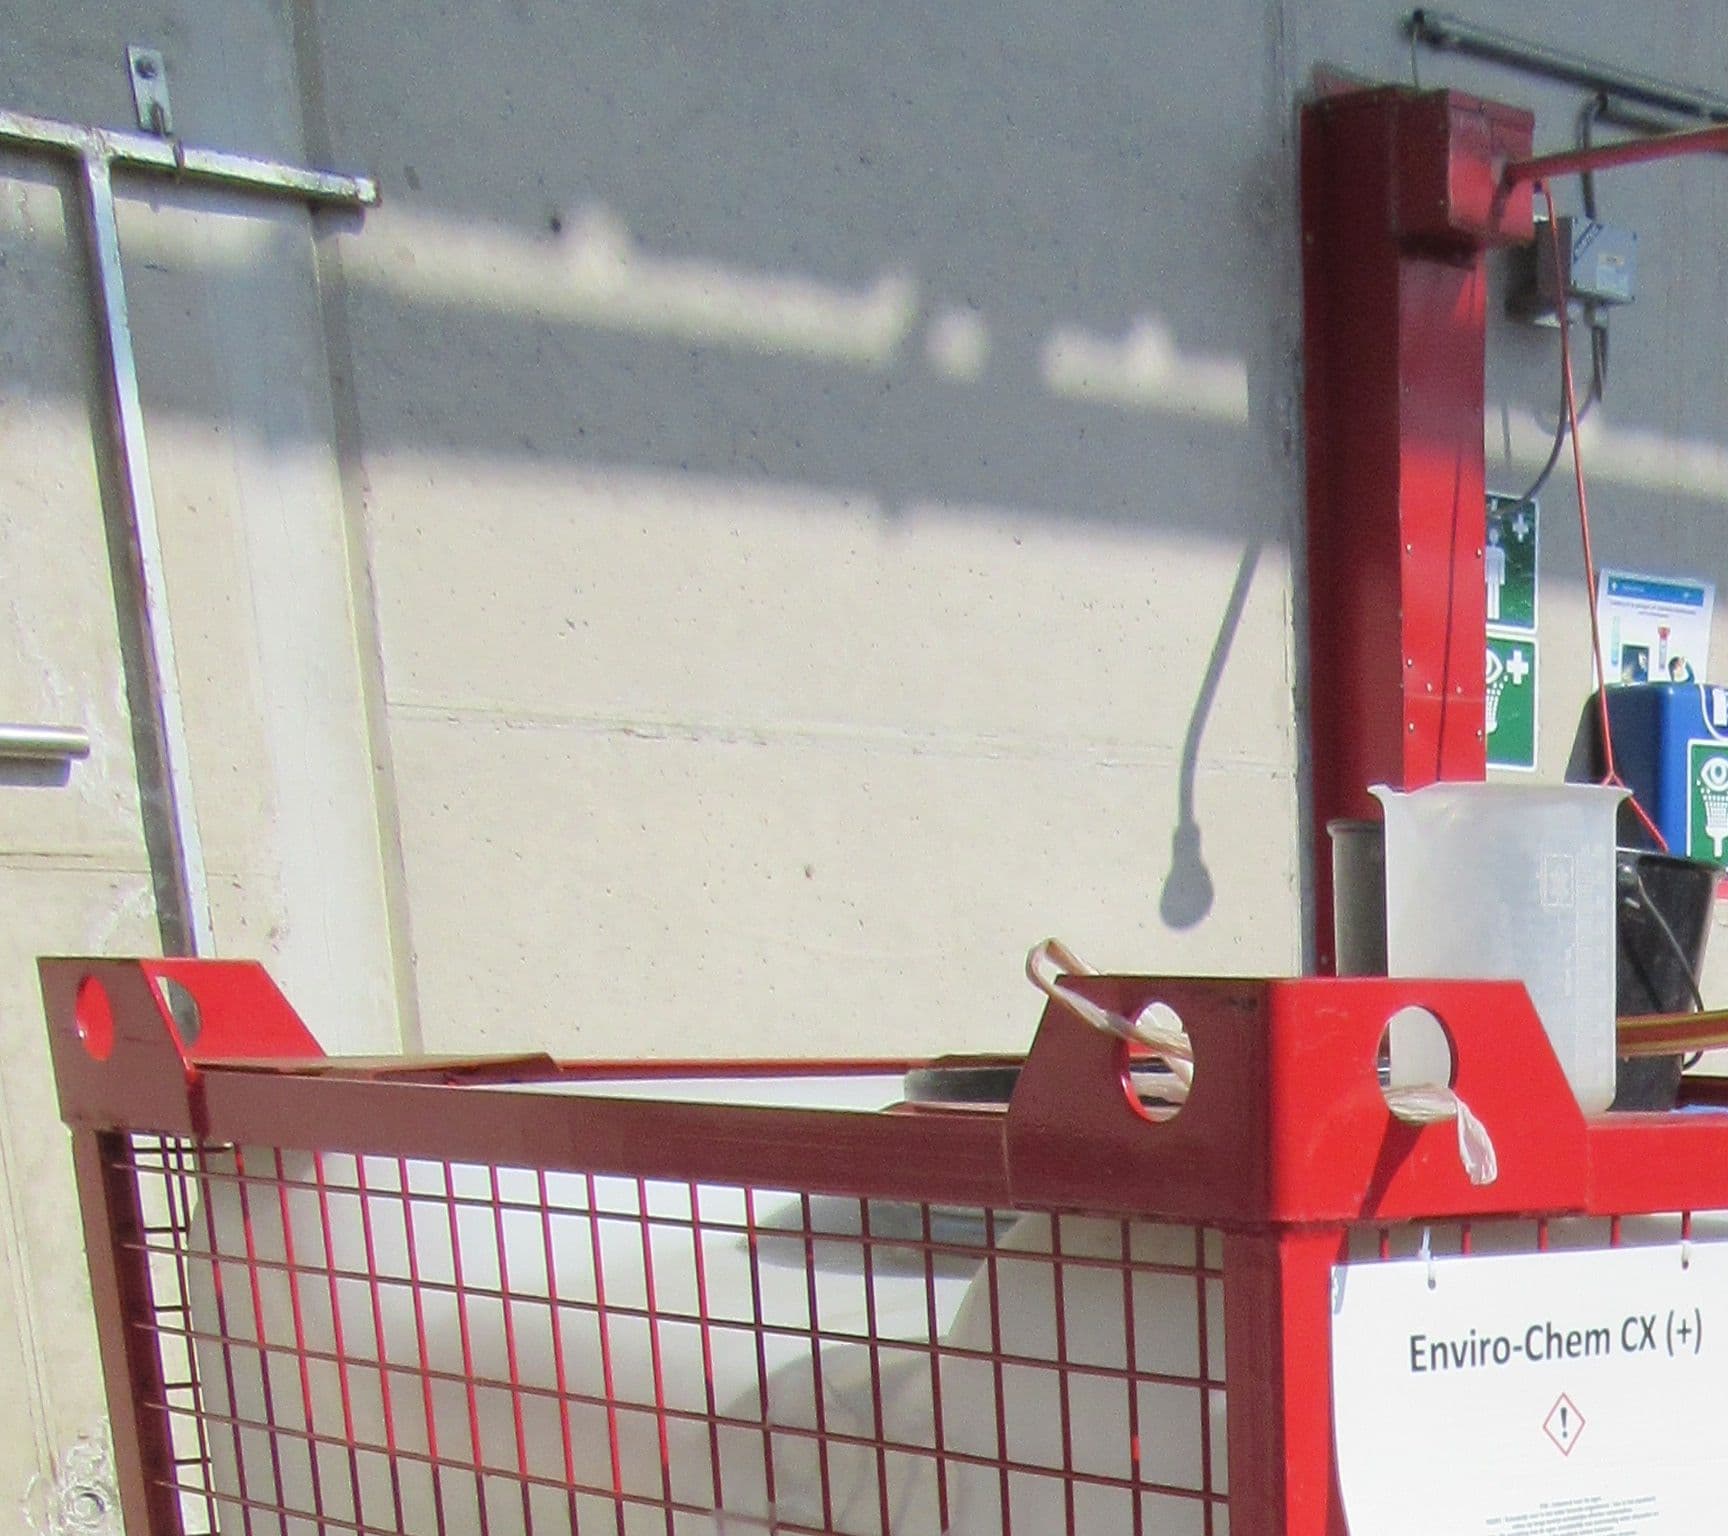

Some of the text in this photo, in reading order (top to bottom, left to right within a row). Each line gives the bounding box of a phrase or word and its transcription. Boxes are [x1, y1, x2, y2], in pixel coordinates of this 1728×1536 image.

[1409, 1307, 1703, 1373] Enviro-Chem CX (+)
